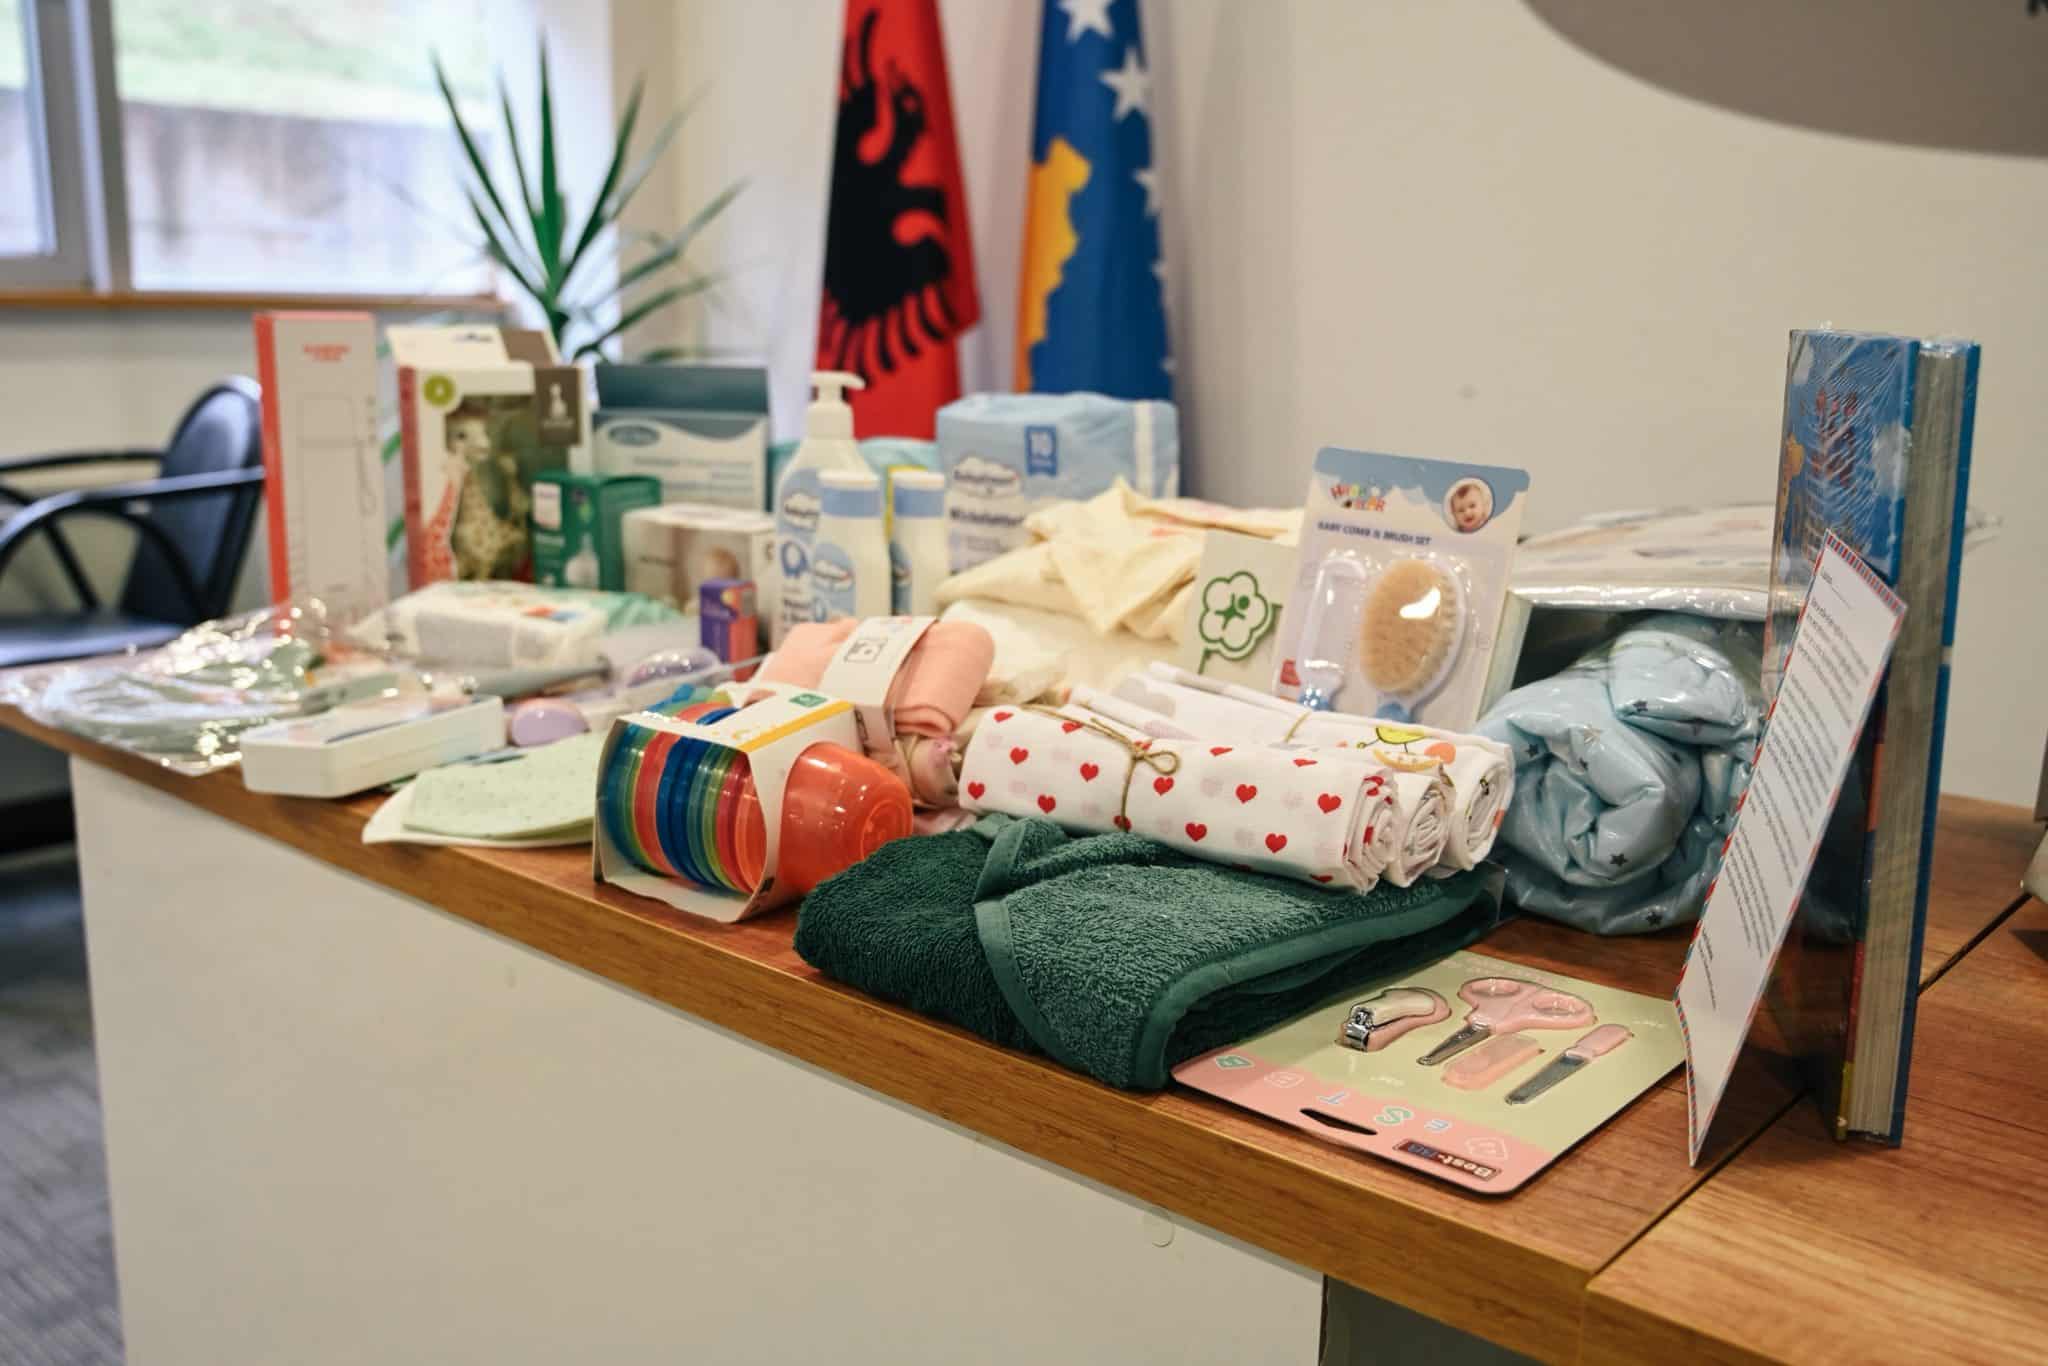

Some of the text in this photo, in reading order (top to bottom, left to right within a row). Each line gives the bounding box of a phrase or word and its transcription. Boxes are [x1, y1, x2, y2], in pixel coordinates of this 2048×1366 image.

[1317, 520, 1341, 532] BABY
[1342, 525, 1371, 537] COMB
[1383, 530, 1413, 543] BRUSH
[1414, 535, 1432, 545] SET
